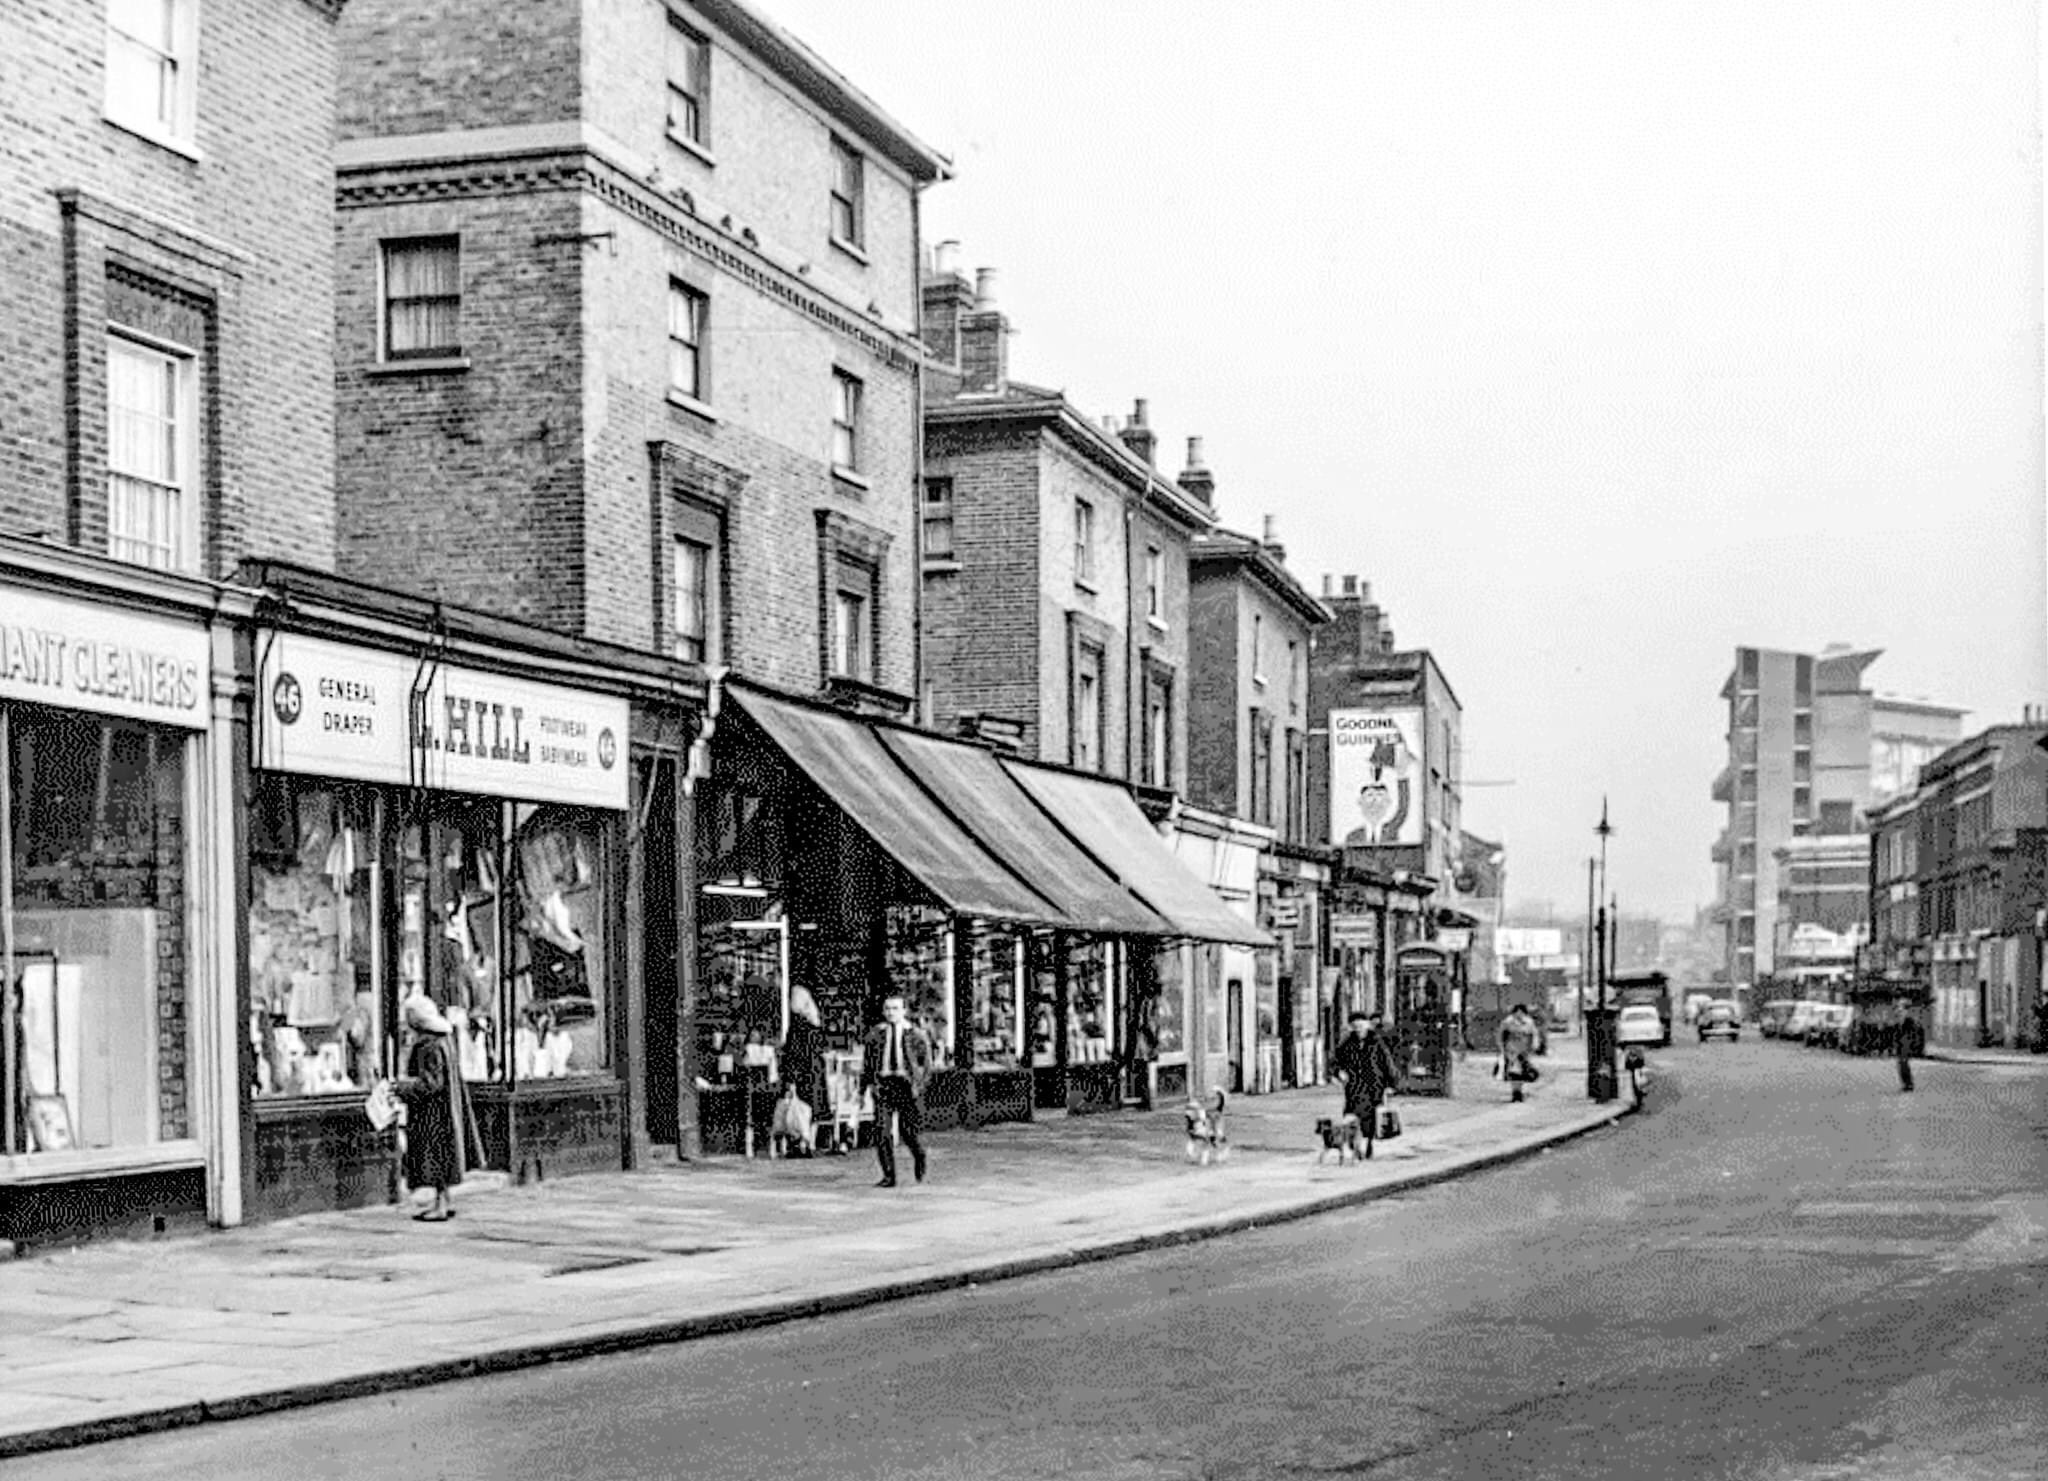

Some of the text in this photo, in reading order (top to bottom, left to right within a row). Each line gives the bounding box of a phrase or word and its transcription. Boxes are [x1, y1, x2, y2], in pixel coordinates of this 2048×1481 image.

[74, 639, 197, 710] CLEANERS
[319, 676, 376, 706] GENERAL
[323, 711, 373, 736] DRAPER
[445, 696, 530, 764] HILL
